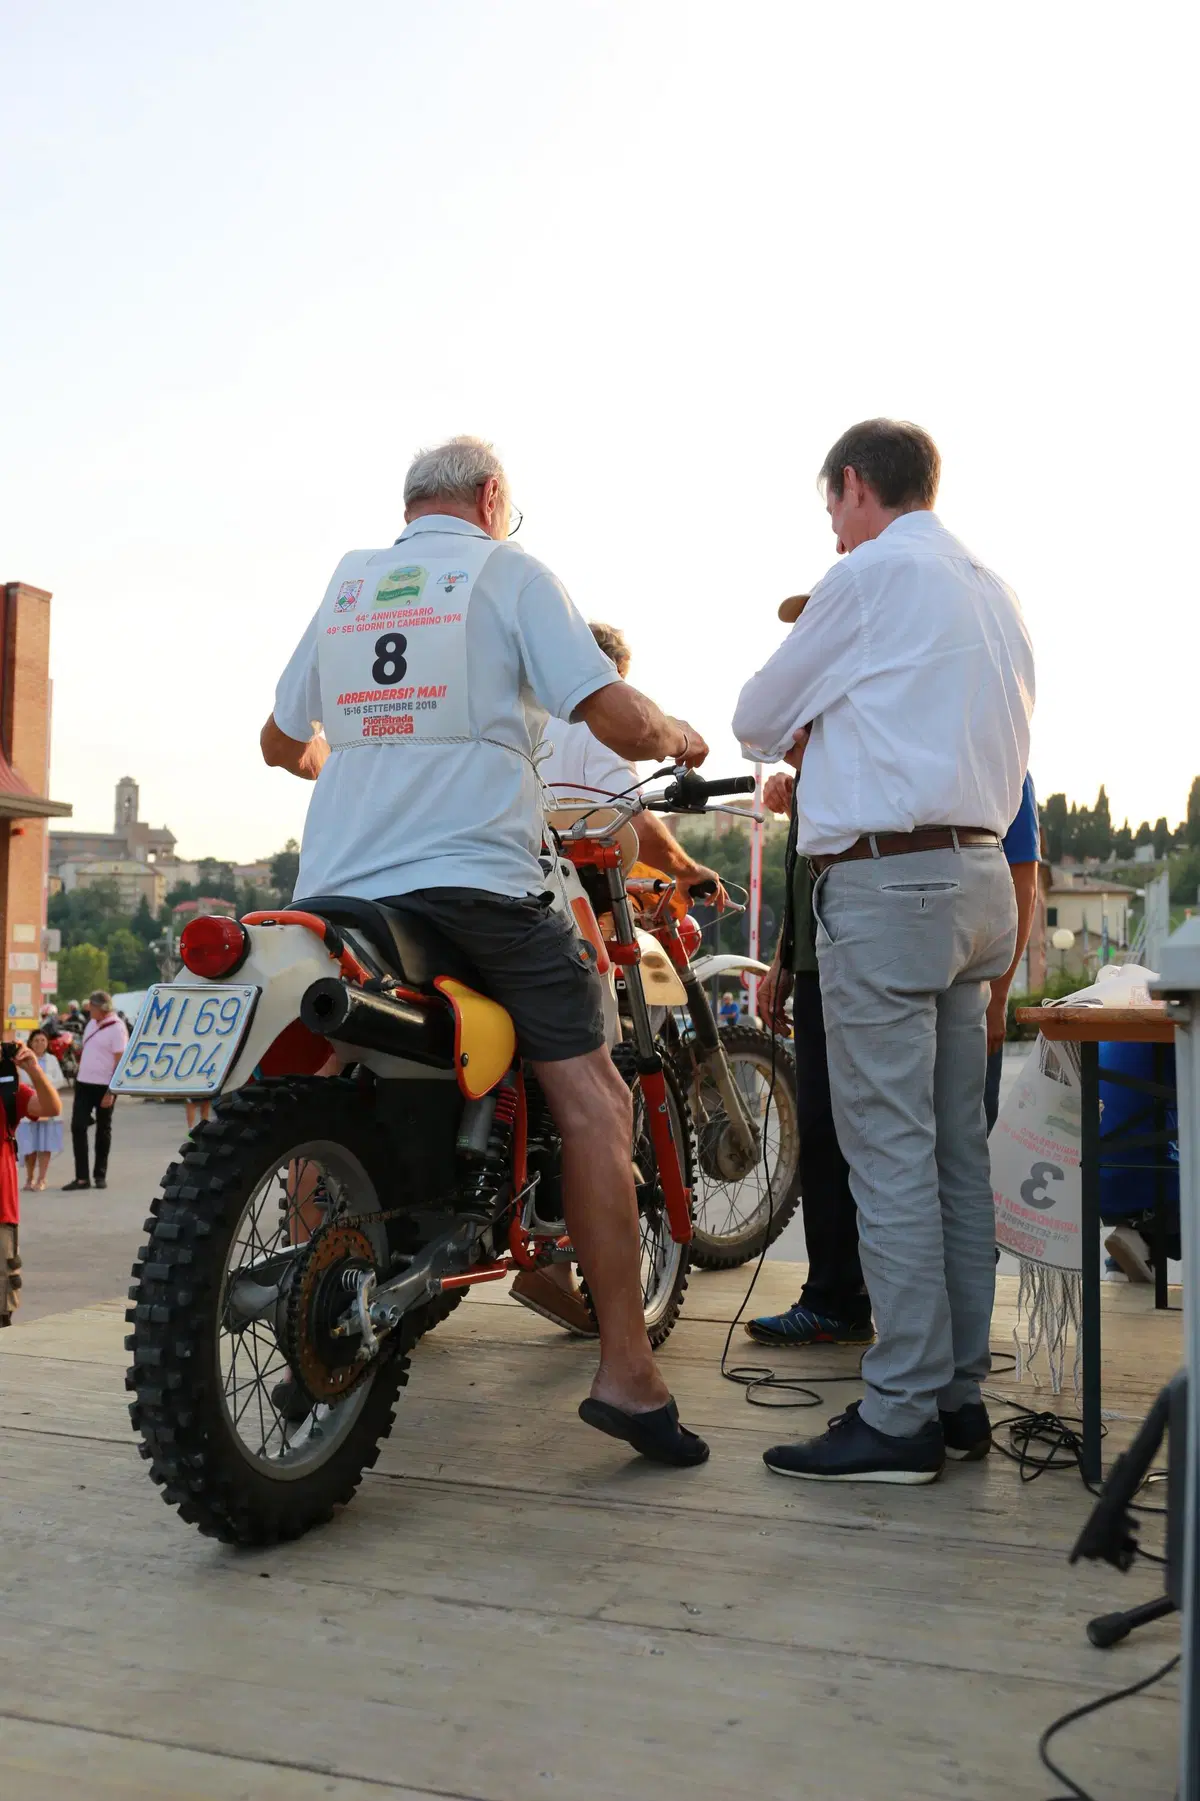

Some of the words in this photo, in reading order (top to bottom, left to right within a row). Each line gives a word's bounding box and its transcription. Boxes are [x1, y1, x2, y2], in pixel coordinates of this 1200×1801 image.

[371, 607, 434, 621] ANNIVERSARIO
[341, 625, 355, 634] SEI
[356, 622, 385, 632] GIORNI
[386, 620, 395, 629] DI
[397, 615, 441, 628] CAMERINO
[372, 632, 408, 685] 8
[336, 687, 415, 705] ARRENDERSI?
[343, 706, 361, 716] 15-16
[362, 702, 413, 714] SETTEMBRE
[415, 700, 437, 710] 2018
[142, 995, 190, 1036] MI
[193, 996, 242, 1036] 69
[124, 1041, 223, 1081] 5504
